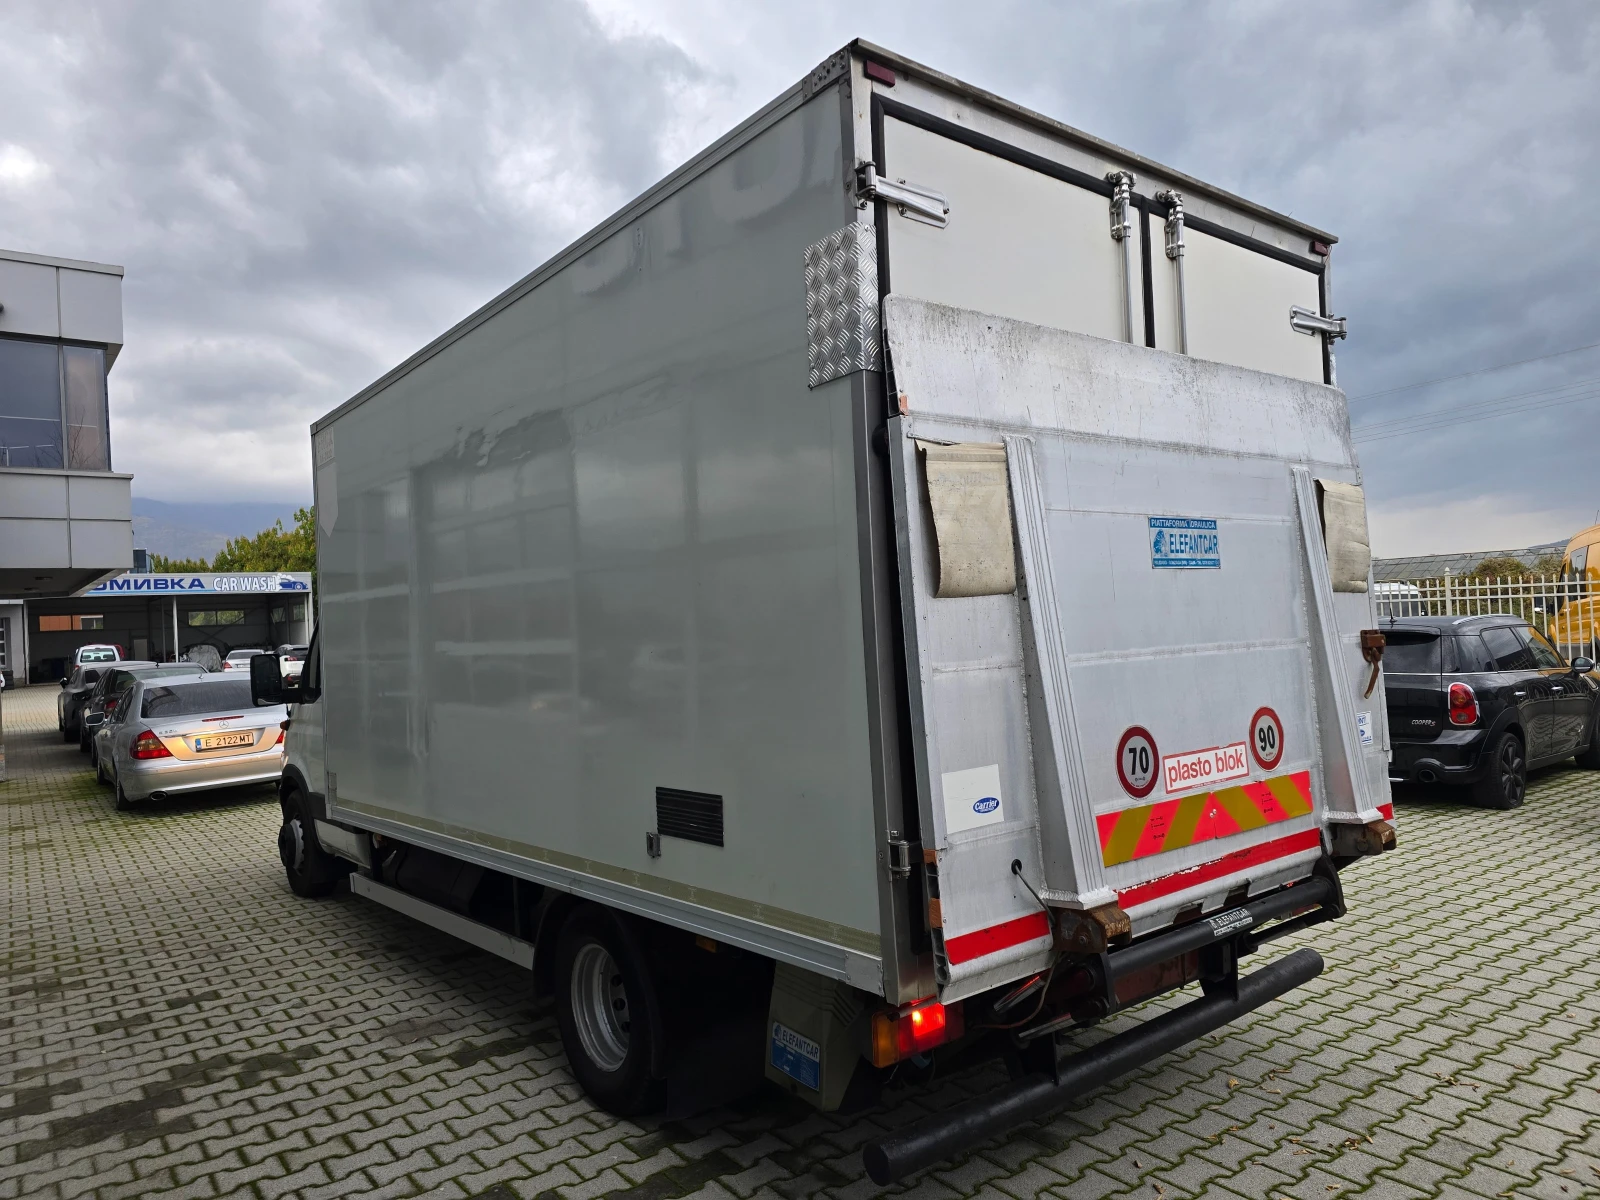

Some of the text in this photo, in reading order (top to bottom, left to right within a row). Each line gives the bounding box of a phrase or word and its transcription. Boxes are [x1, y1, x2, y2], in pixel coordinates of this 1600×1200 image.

[1151, 519, 1216, 529] PIATTAFORMA IDRAULICA
[1169, 533, 1219, 554] ELEFANTCAR
[213, 575, 277, 592] CAR WASH
[1258, 724, 1276, 752] 90
[1128, 746, 1150, 776] 70
[1167, 757, 1212, 788] plasto
[1214, 749, 1245, 774] blok
[974, 799, 998, 811] Carrier
[782, 1029, 820, 1060] ELEFANTCAR
